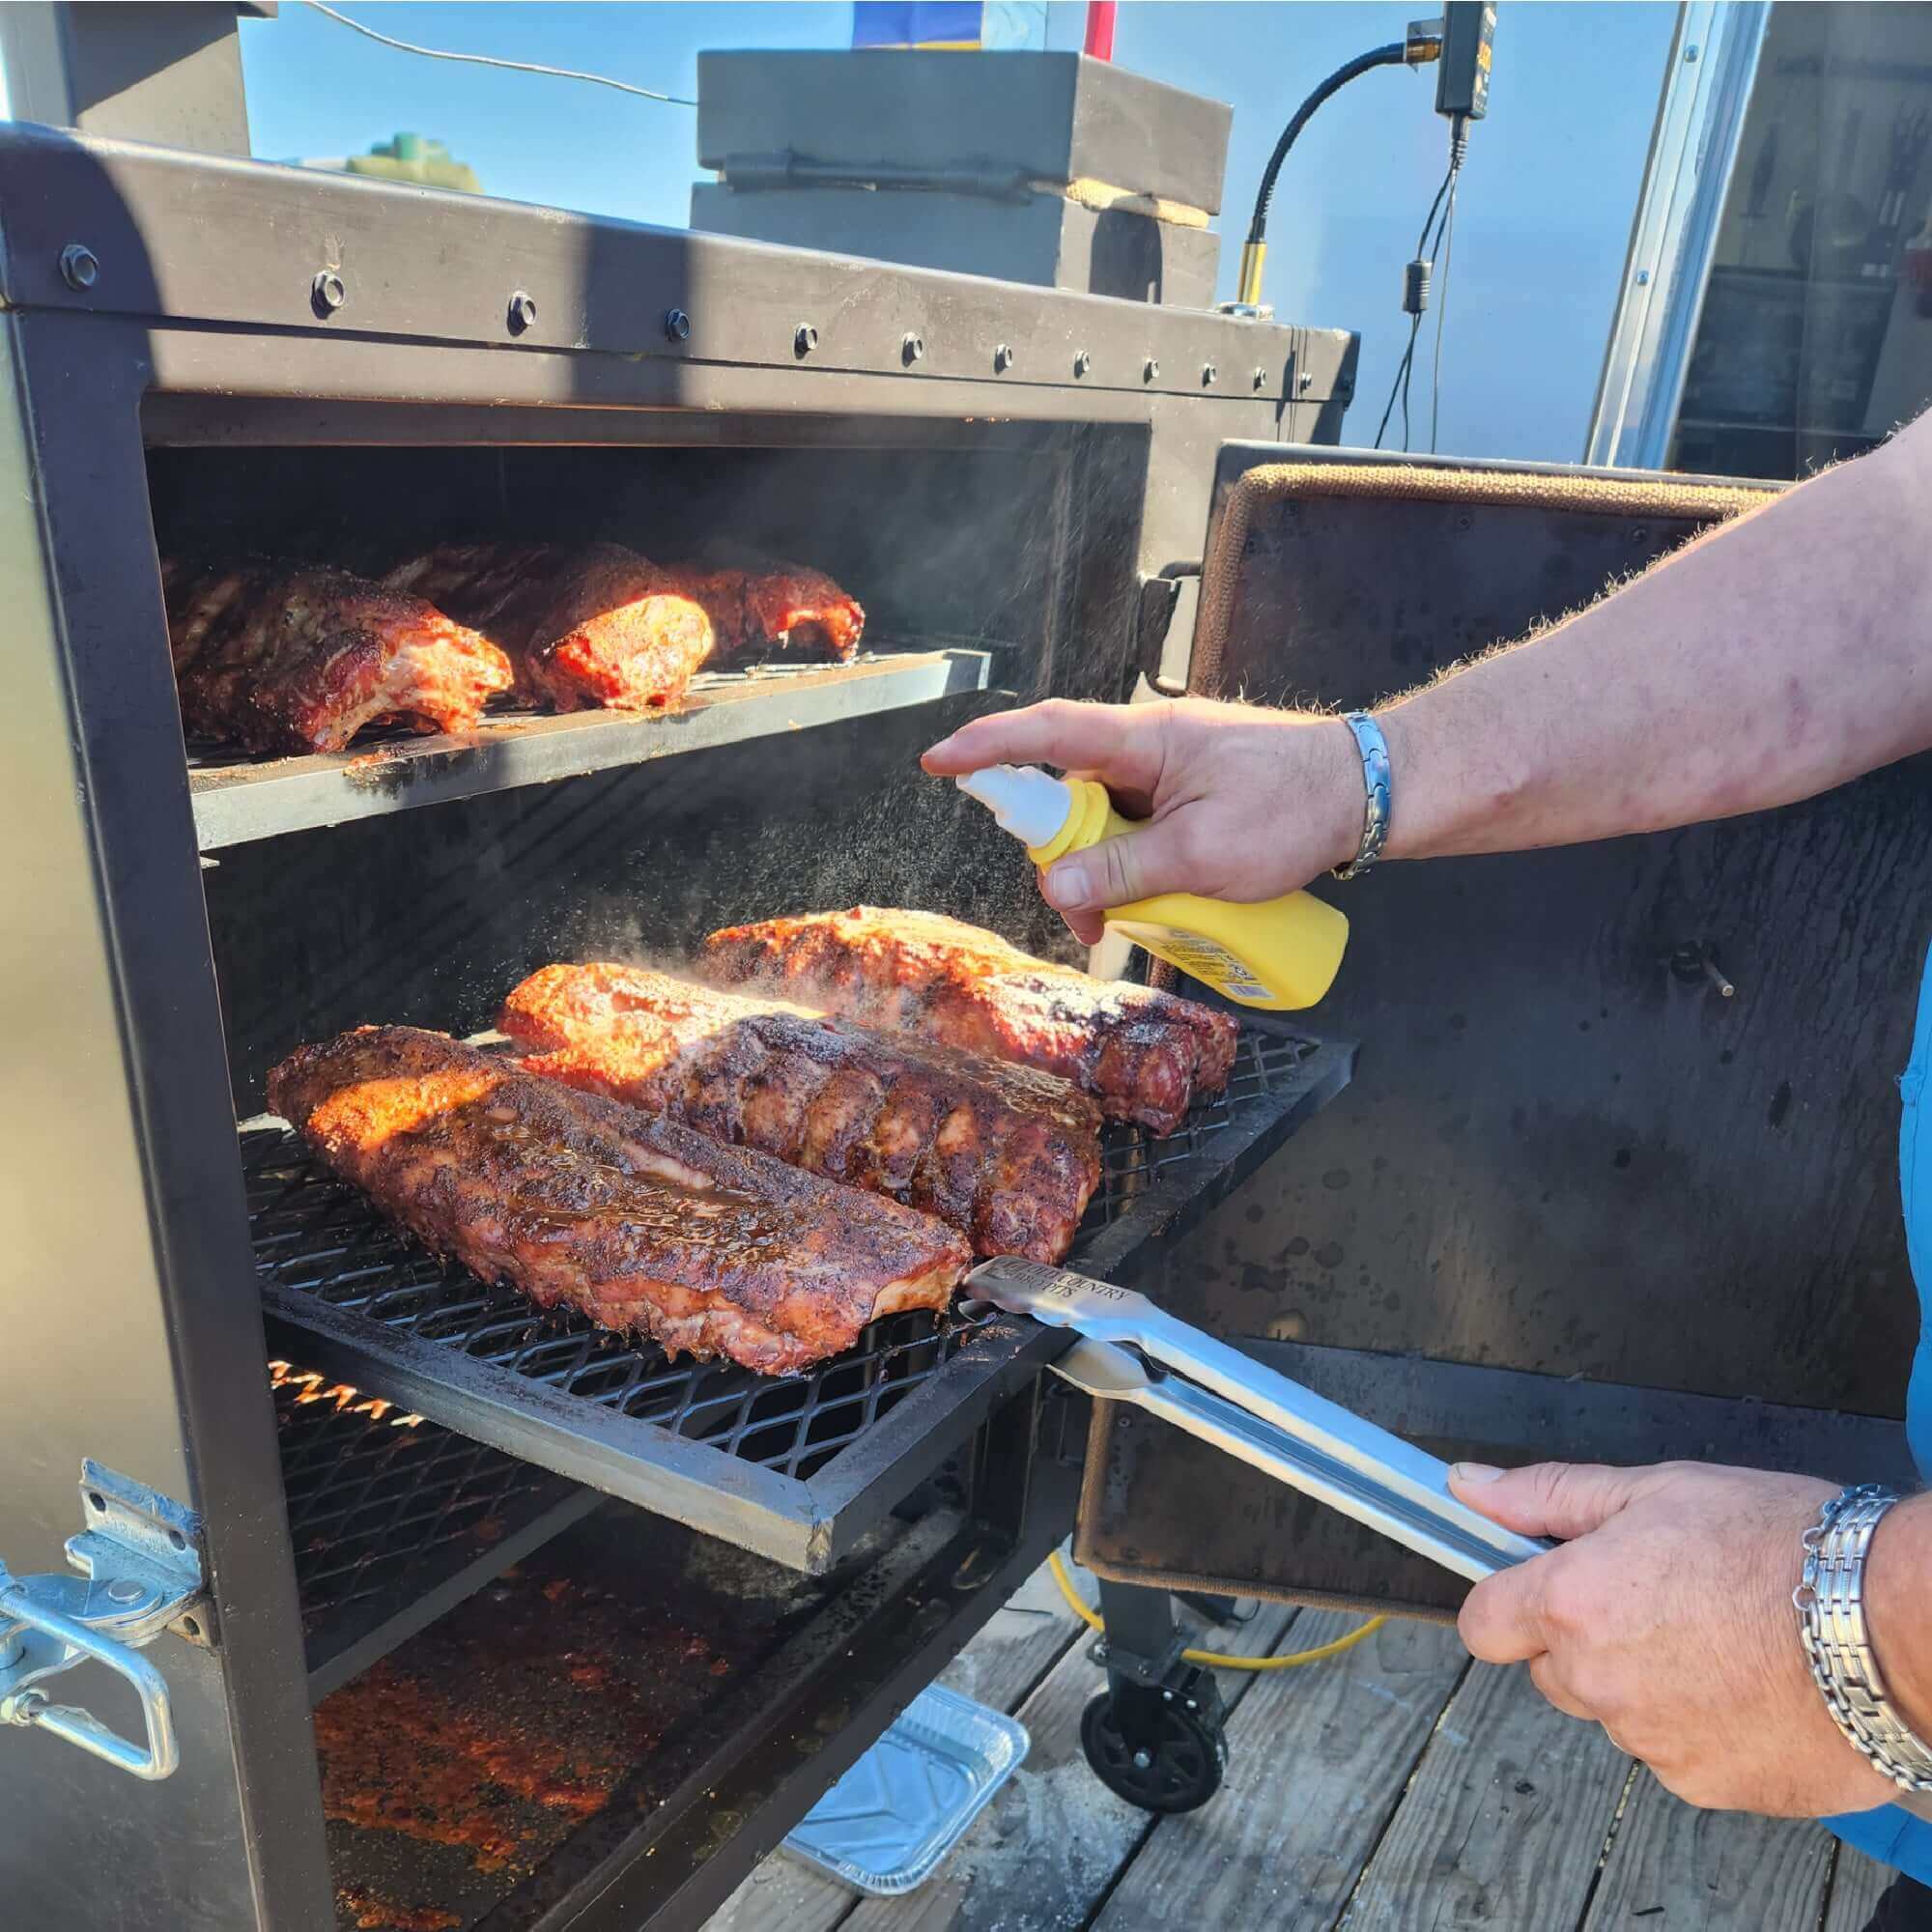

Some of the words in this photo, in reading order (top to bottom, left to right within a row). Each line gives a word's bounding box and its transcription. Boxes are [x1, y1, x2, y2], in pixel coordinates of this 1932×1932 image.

[1027, 1264, 1060, 1280] OLD
[1057, 1274, 1128, 1300] COUNTRY
[1042, 1281, 1077, 1297] PITS
